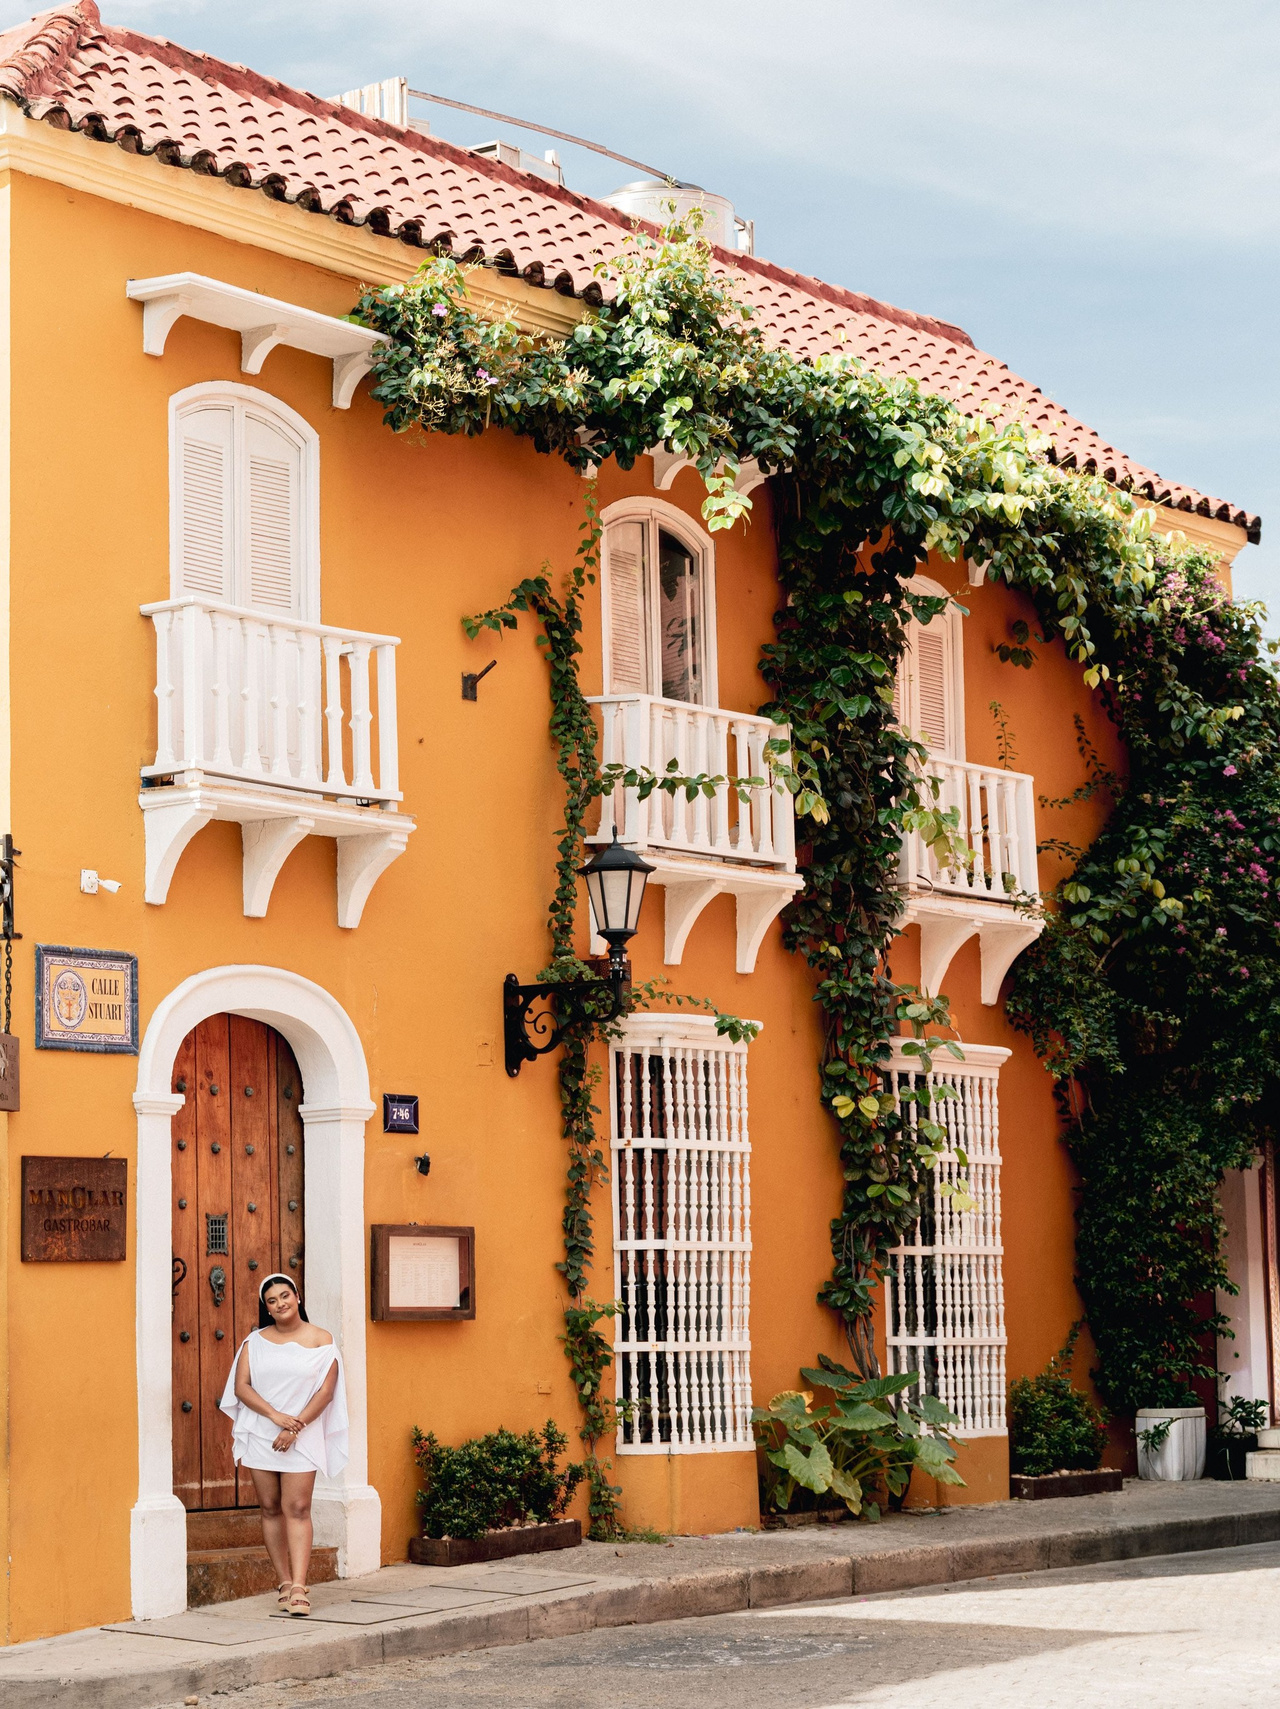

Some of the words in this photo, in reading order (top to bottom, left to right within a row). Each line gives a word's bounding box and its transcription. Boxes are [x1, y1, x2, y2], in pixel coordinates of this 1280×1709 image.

[91, 978, 119, 996] CALLE
[88, 1002, 123, 1021] STUART
[29, 1186, 124, 1209] MANGLAR
[43, 1218, 110, 1232] GASTROBAR
